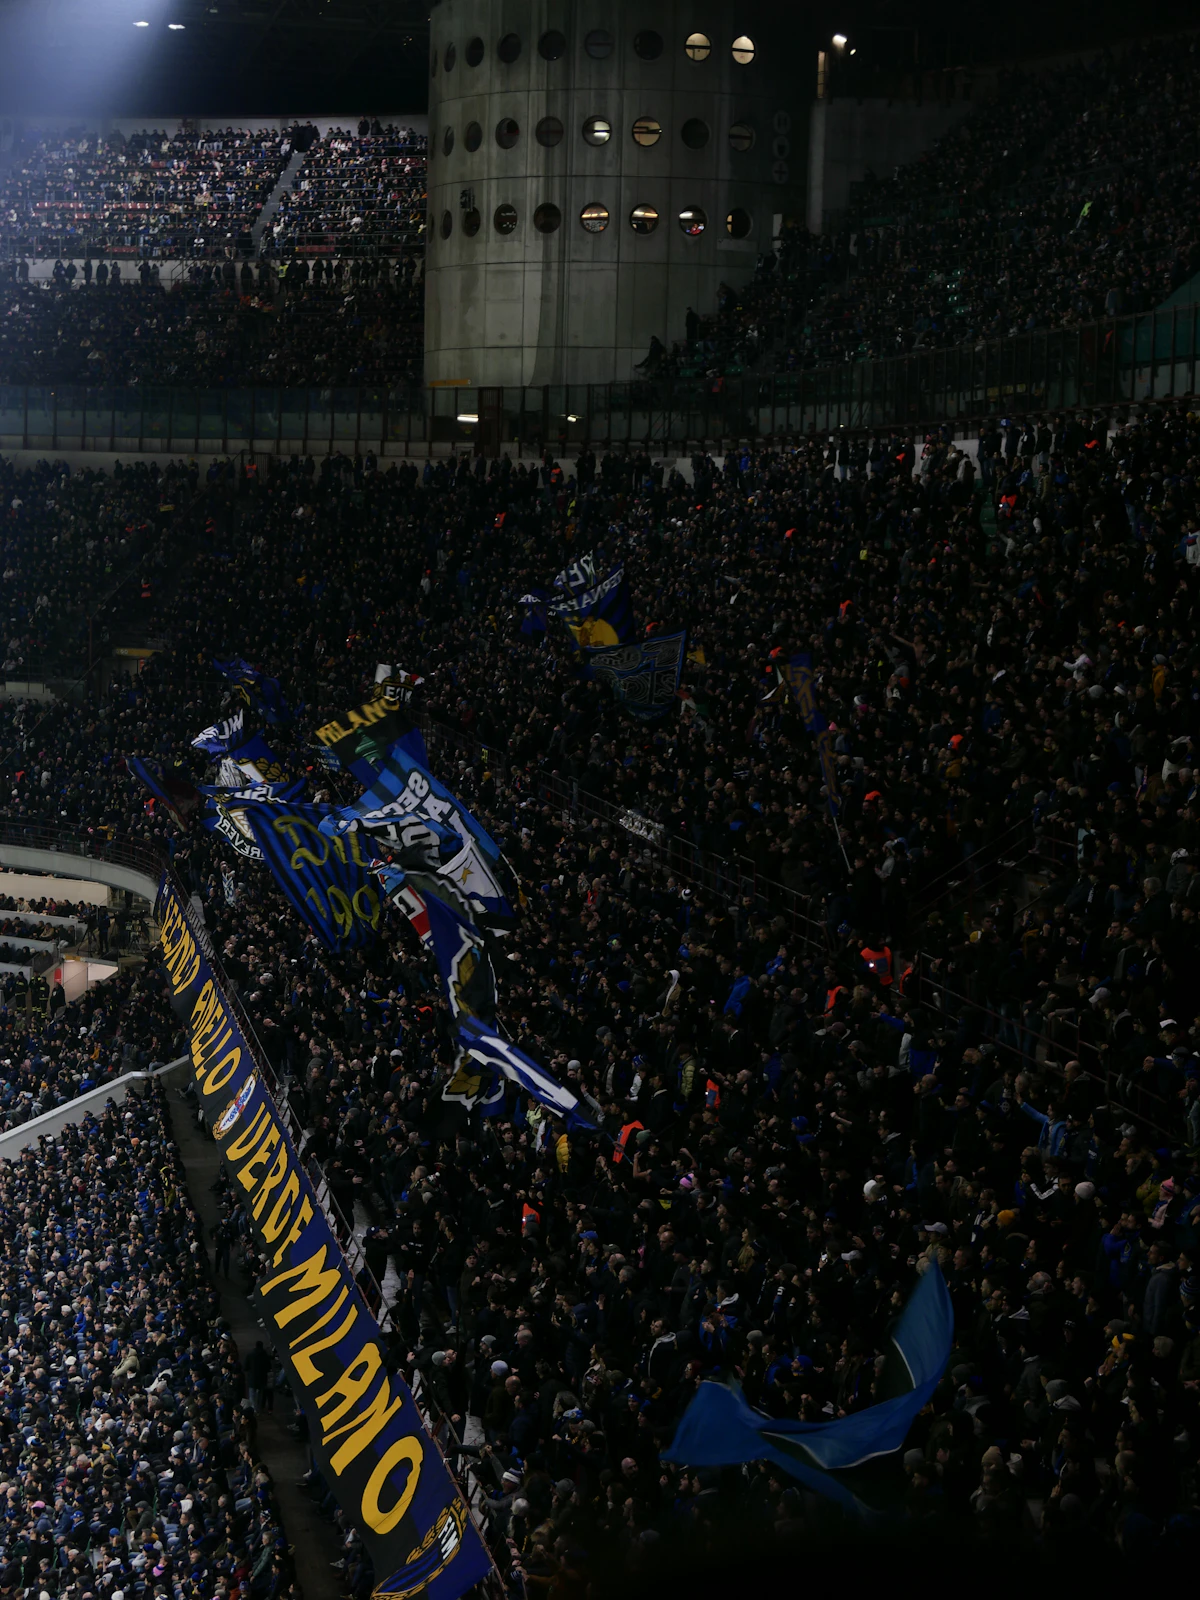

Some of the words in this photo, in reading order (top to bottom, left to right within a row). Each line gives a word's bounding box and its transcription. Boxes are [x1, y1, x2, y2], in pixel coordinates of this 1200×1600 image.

[314, 696, 401, 747] MILANO
[160, 894, 201, 996] SECONDO
[190, 978, 242, 1096] ANELLO
[226, 1102, 315, 1268] VERDE
[260, 1243, 425, 1535] MILANO
